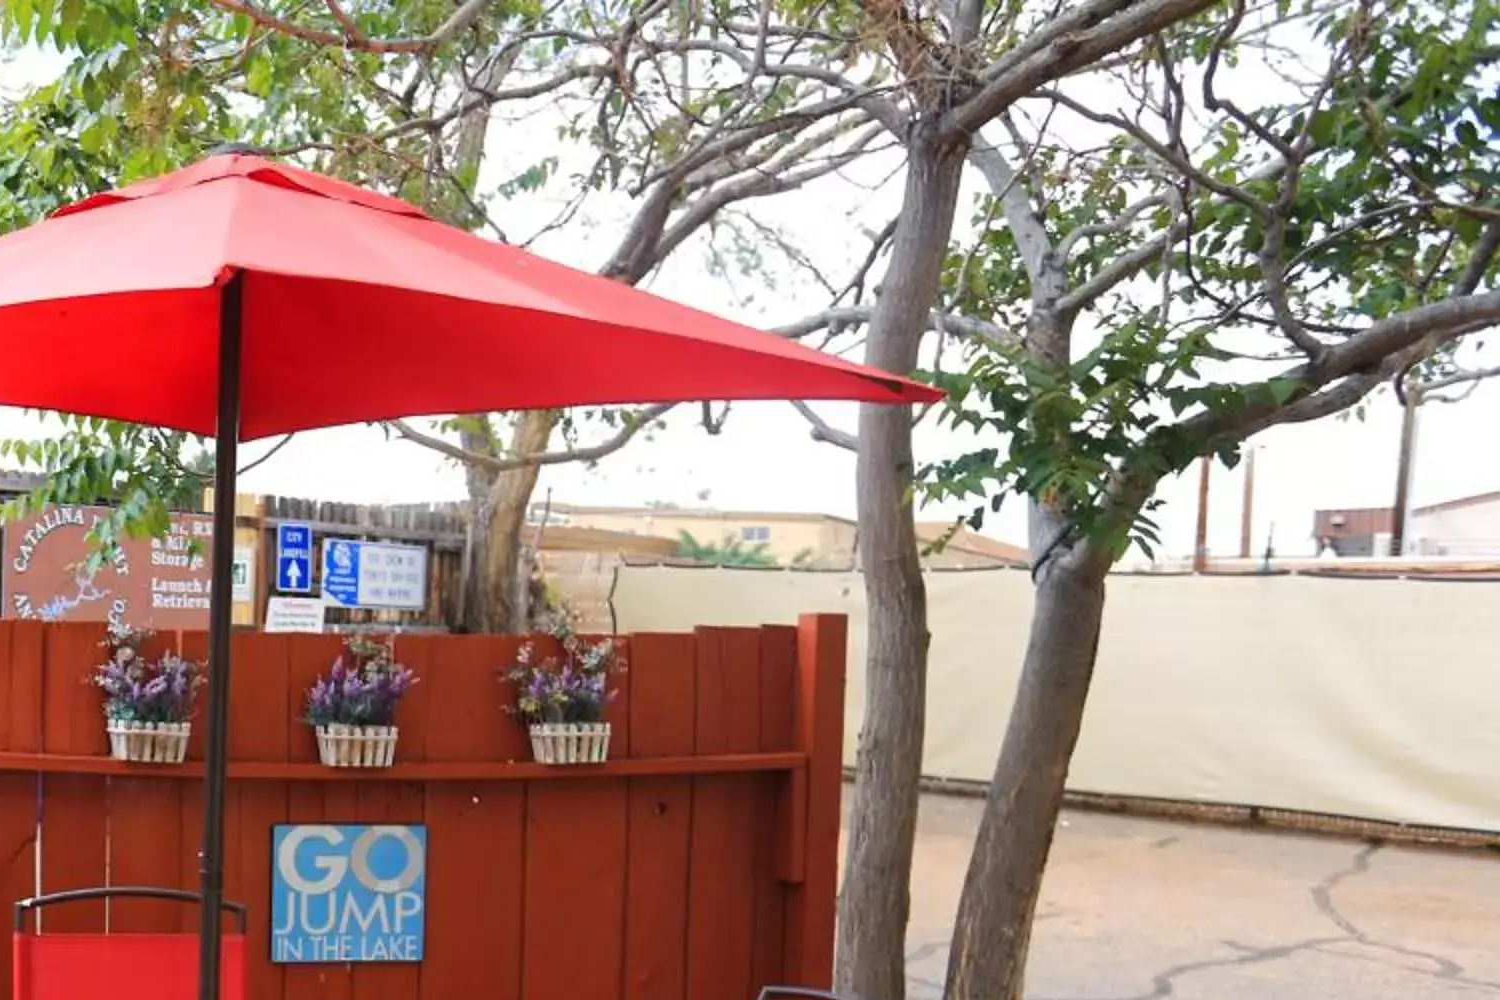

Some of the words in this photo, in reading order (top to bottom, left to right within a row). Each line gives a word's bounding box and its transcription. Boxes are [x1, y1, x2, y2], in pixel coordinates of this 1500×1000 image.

[12, 506, 85, 573] CATALINA
[151, 577, 202, 593] Launch
[152, 594, 211, 608] Retrieva
[277, 824, 424, 895] GO
[274, 889, 421, 935] JUMP
[276, 935, 303, 961] IN
[308, 935, 353, 961] THE
[360, 935, 418, 961] LAKE
